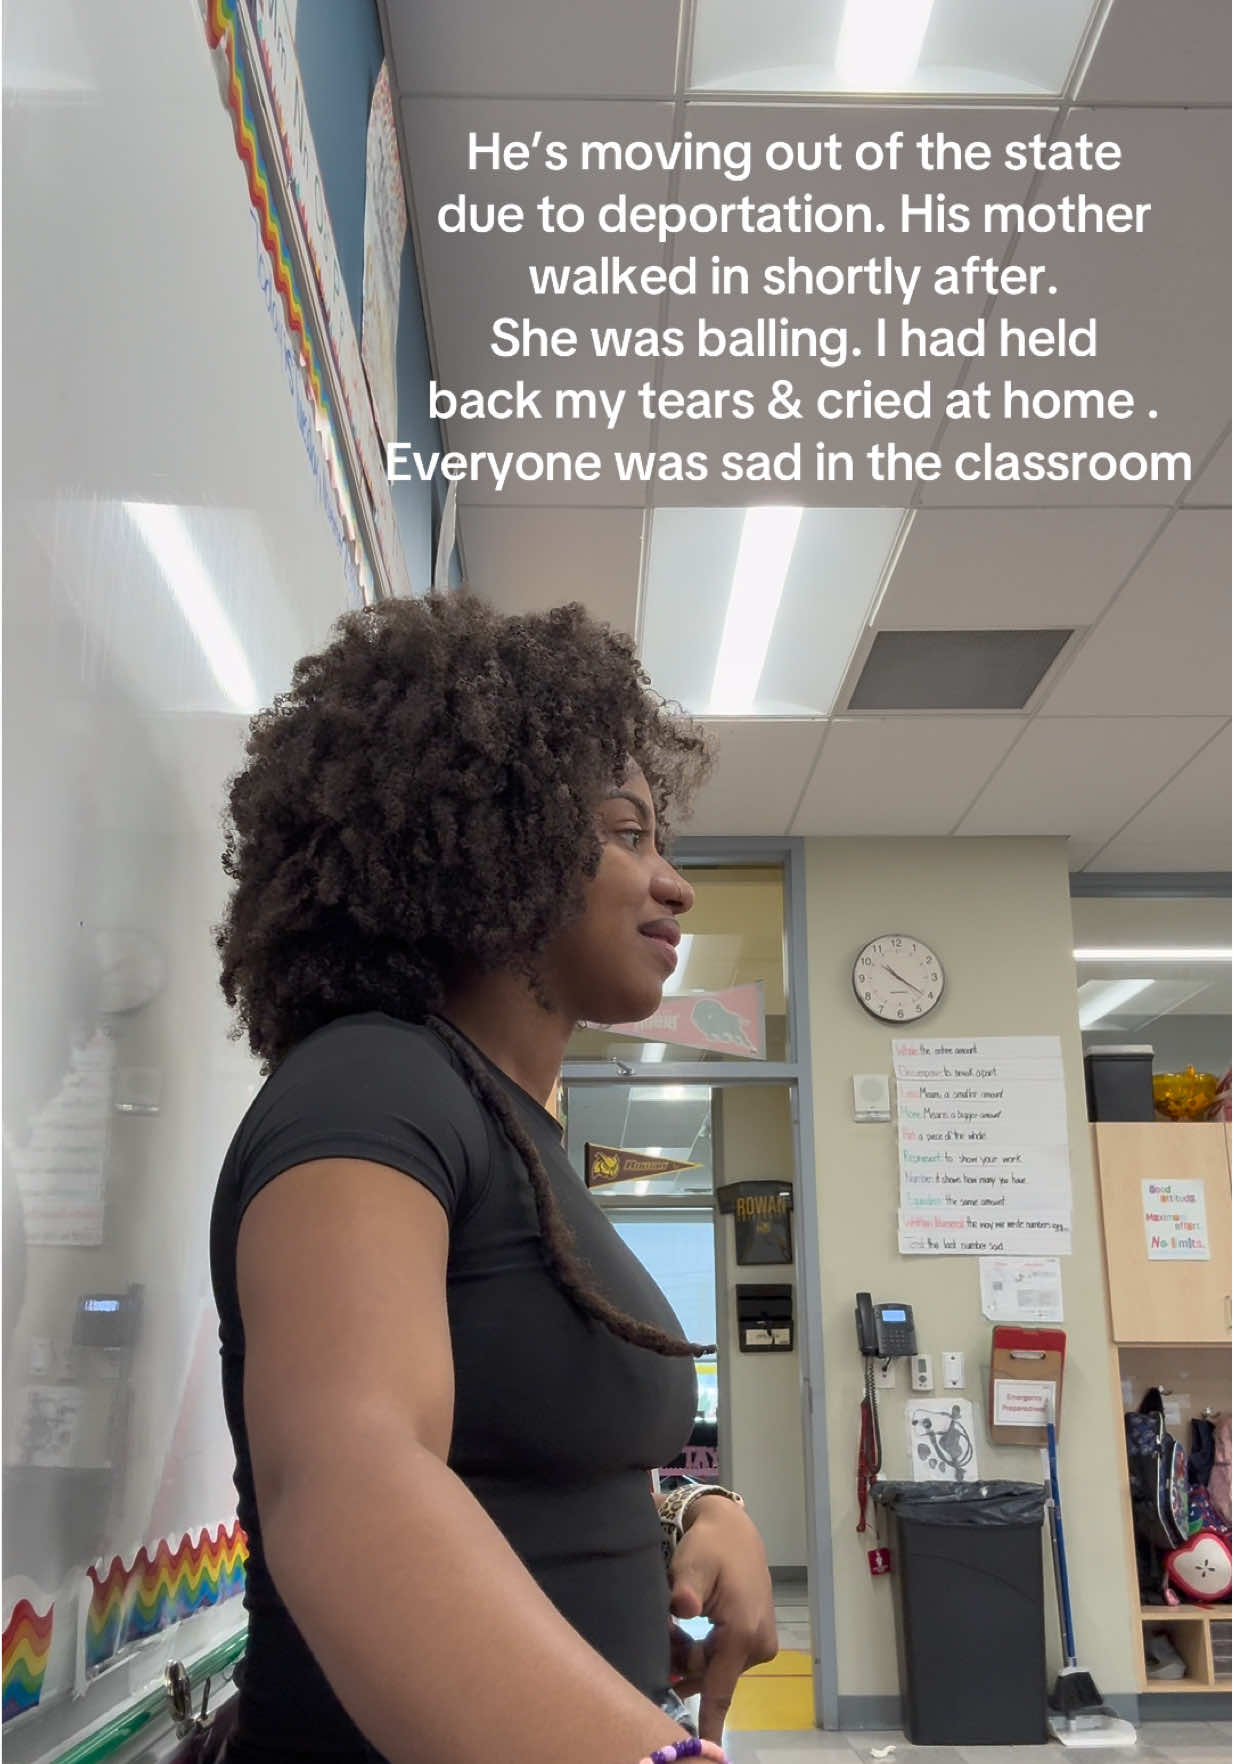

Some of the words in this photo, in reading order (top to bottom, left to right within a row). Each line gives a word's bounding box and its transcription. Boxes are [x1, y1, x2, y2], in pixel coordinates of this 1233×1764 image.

[891, 938, 902, 947] 12
[873, 945, 882, 953] 11
[912, 944, 917, 952] 1
[861, 957, 872, 966] 10
[926, 956, 932, 964] 2
[859, 974, 865, 983] 9
[931, 973, 938, 981] 3
[865, 992, 871, 1000] 8
[878, 1004, 884, 1014] 7
[915, 1004, 922, 1012] 5
[897, 1009, 904, 1018] 6
[945, 1152, 953, 1162] to
[980, 1155, 998, 1166] your
[1149, 1184, 1171, 1194] Good
[737, 1195, 787, 1216] ROWAN
[1152, 1236, 1168, 1248] No
